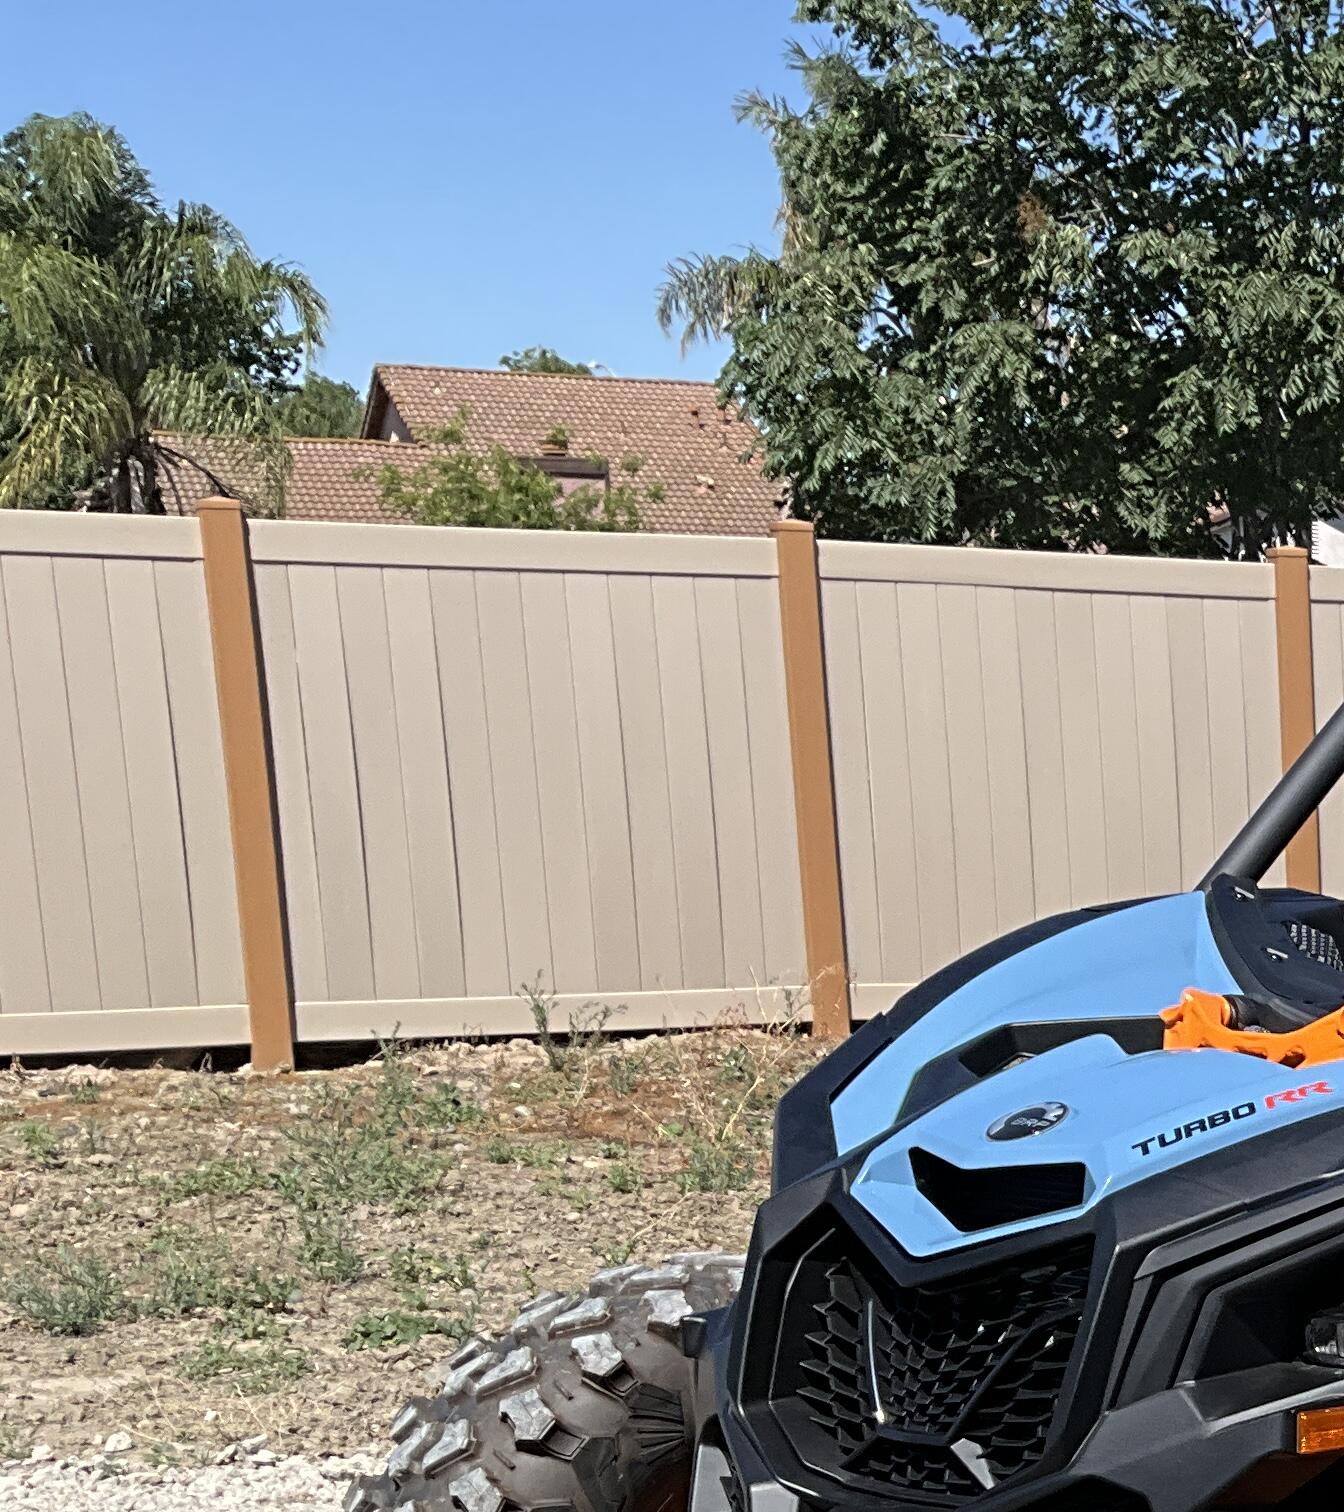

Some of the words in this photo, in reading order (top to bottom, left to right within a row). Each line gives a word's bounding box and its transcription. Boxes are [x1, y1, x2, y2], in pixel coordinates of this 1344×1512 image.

[1011, 1116, 1049, 1127] BRP
[1131, 1102, 1256, 1156] TURBO
[1265, 1080, 1335, 1110] RR
